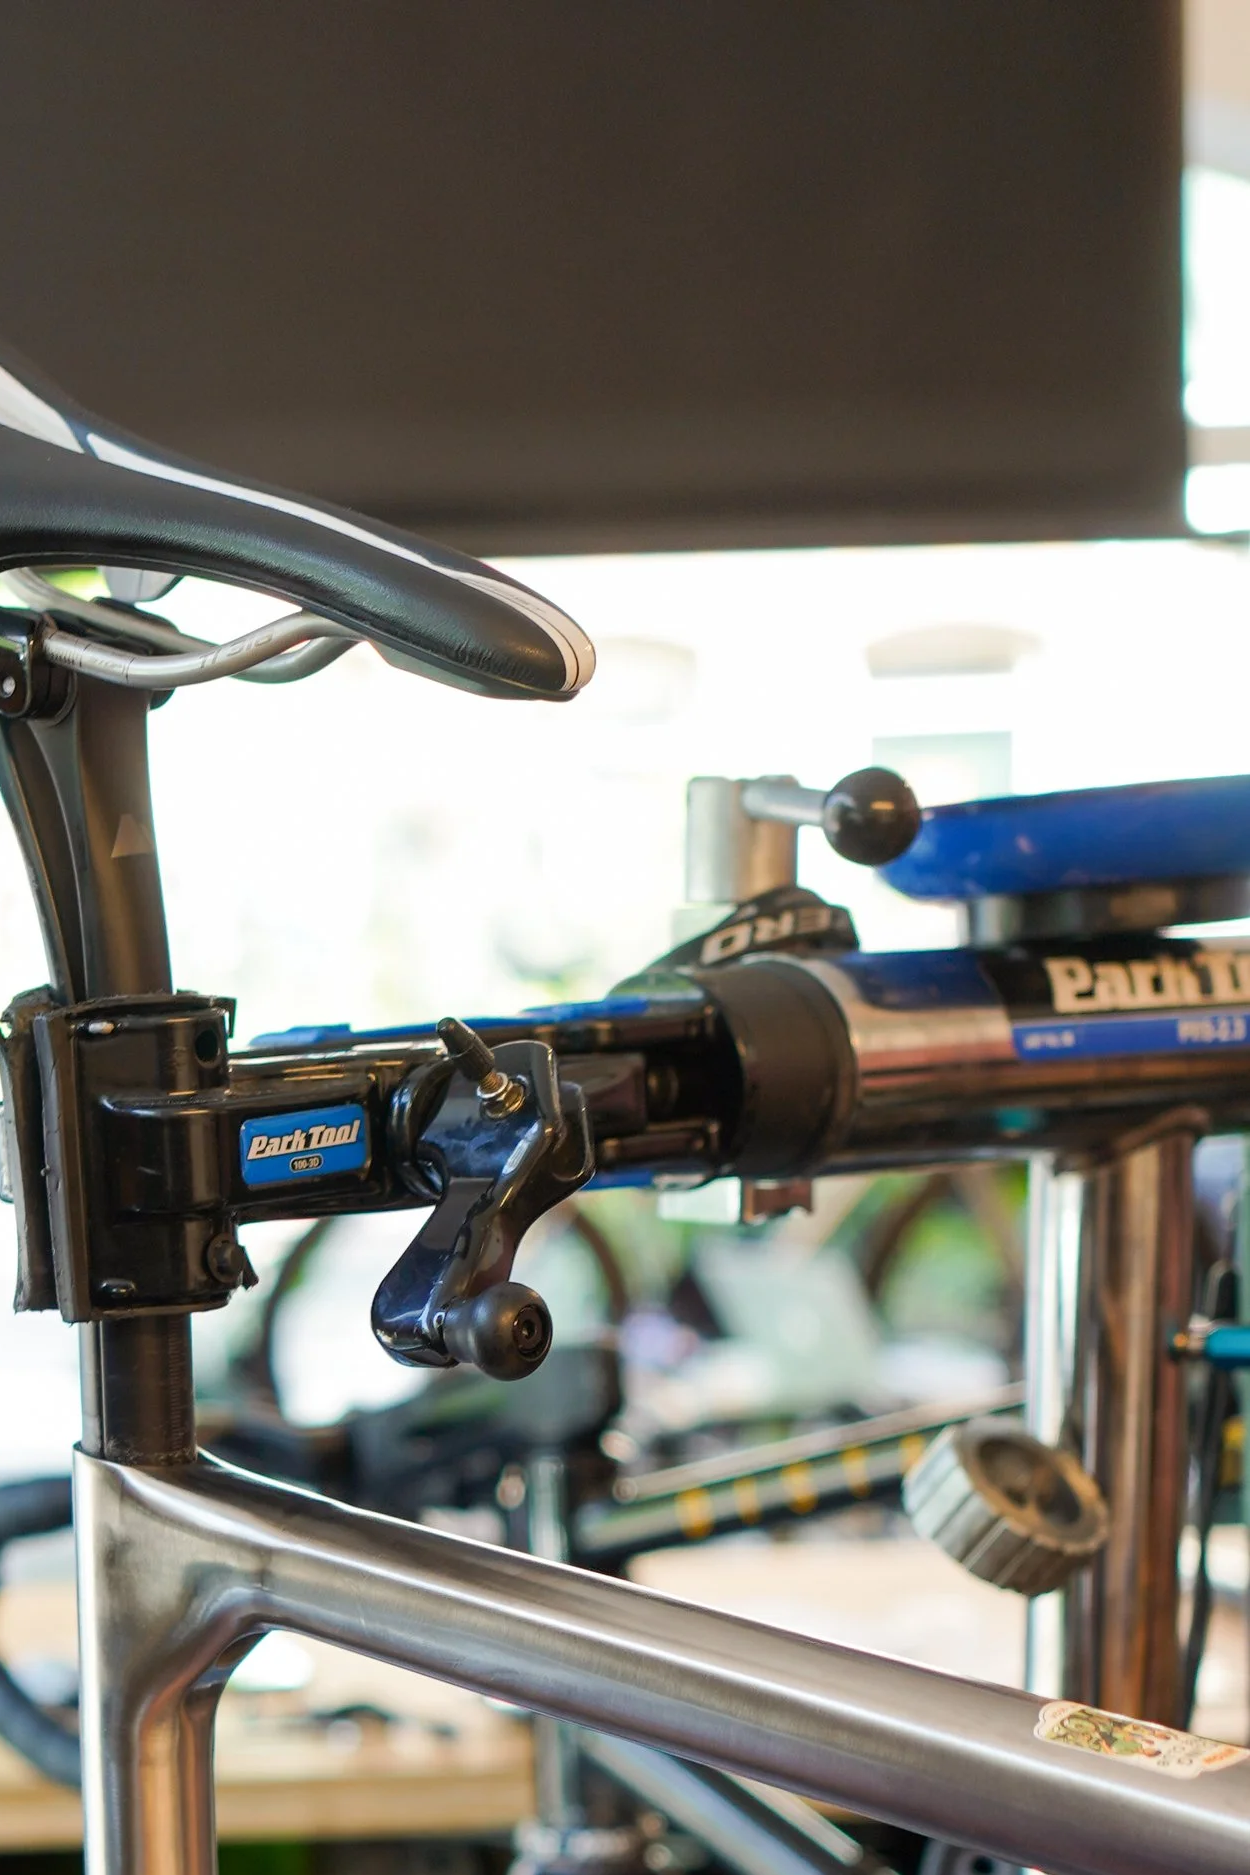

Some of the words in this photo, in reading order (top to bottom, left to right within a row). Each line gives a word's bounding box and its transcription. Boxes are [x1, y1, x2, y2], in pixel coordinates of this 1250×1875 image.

[1044, 955, 1202, 1015] Park
[247, 1129, 308, 1161] Park
[308, 1119, 361, 1150] Tool
[293, 1157, 319, 1171] 100-3D
